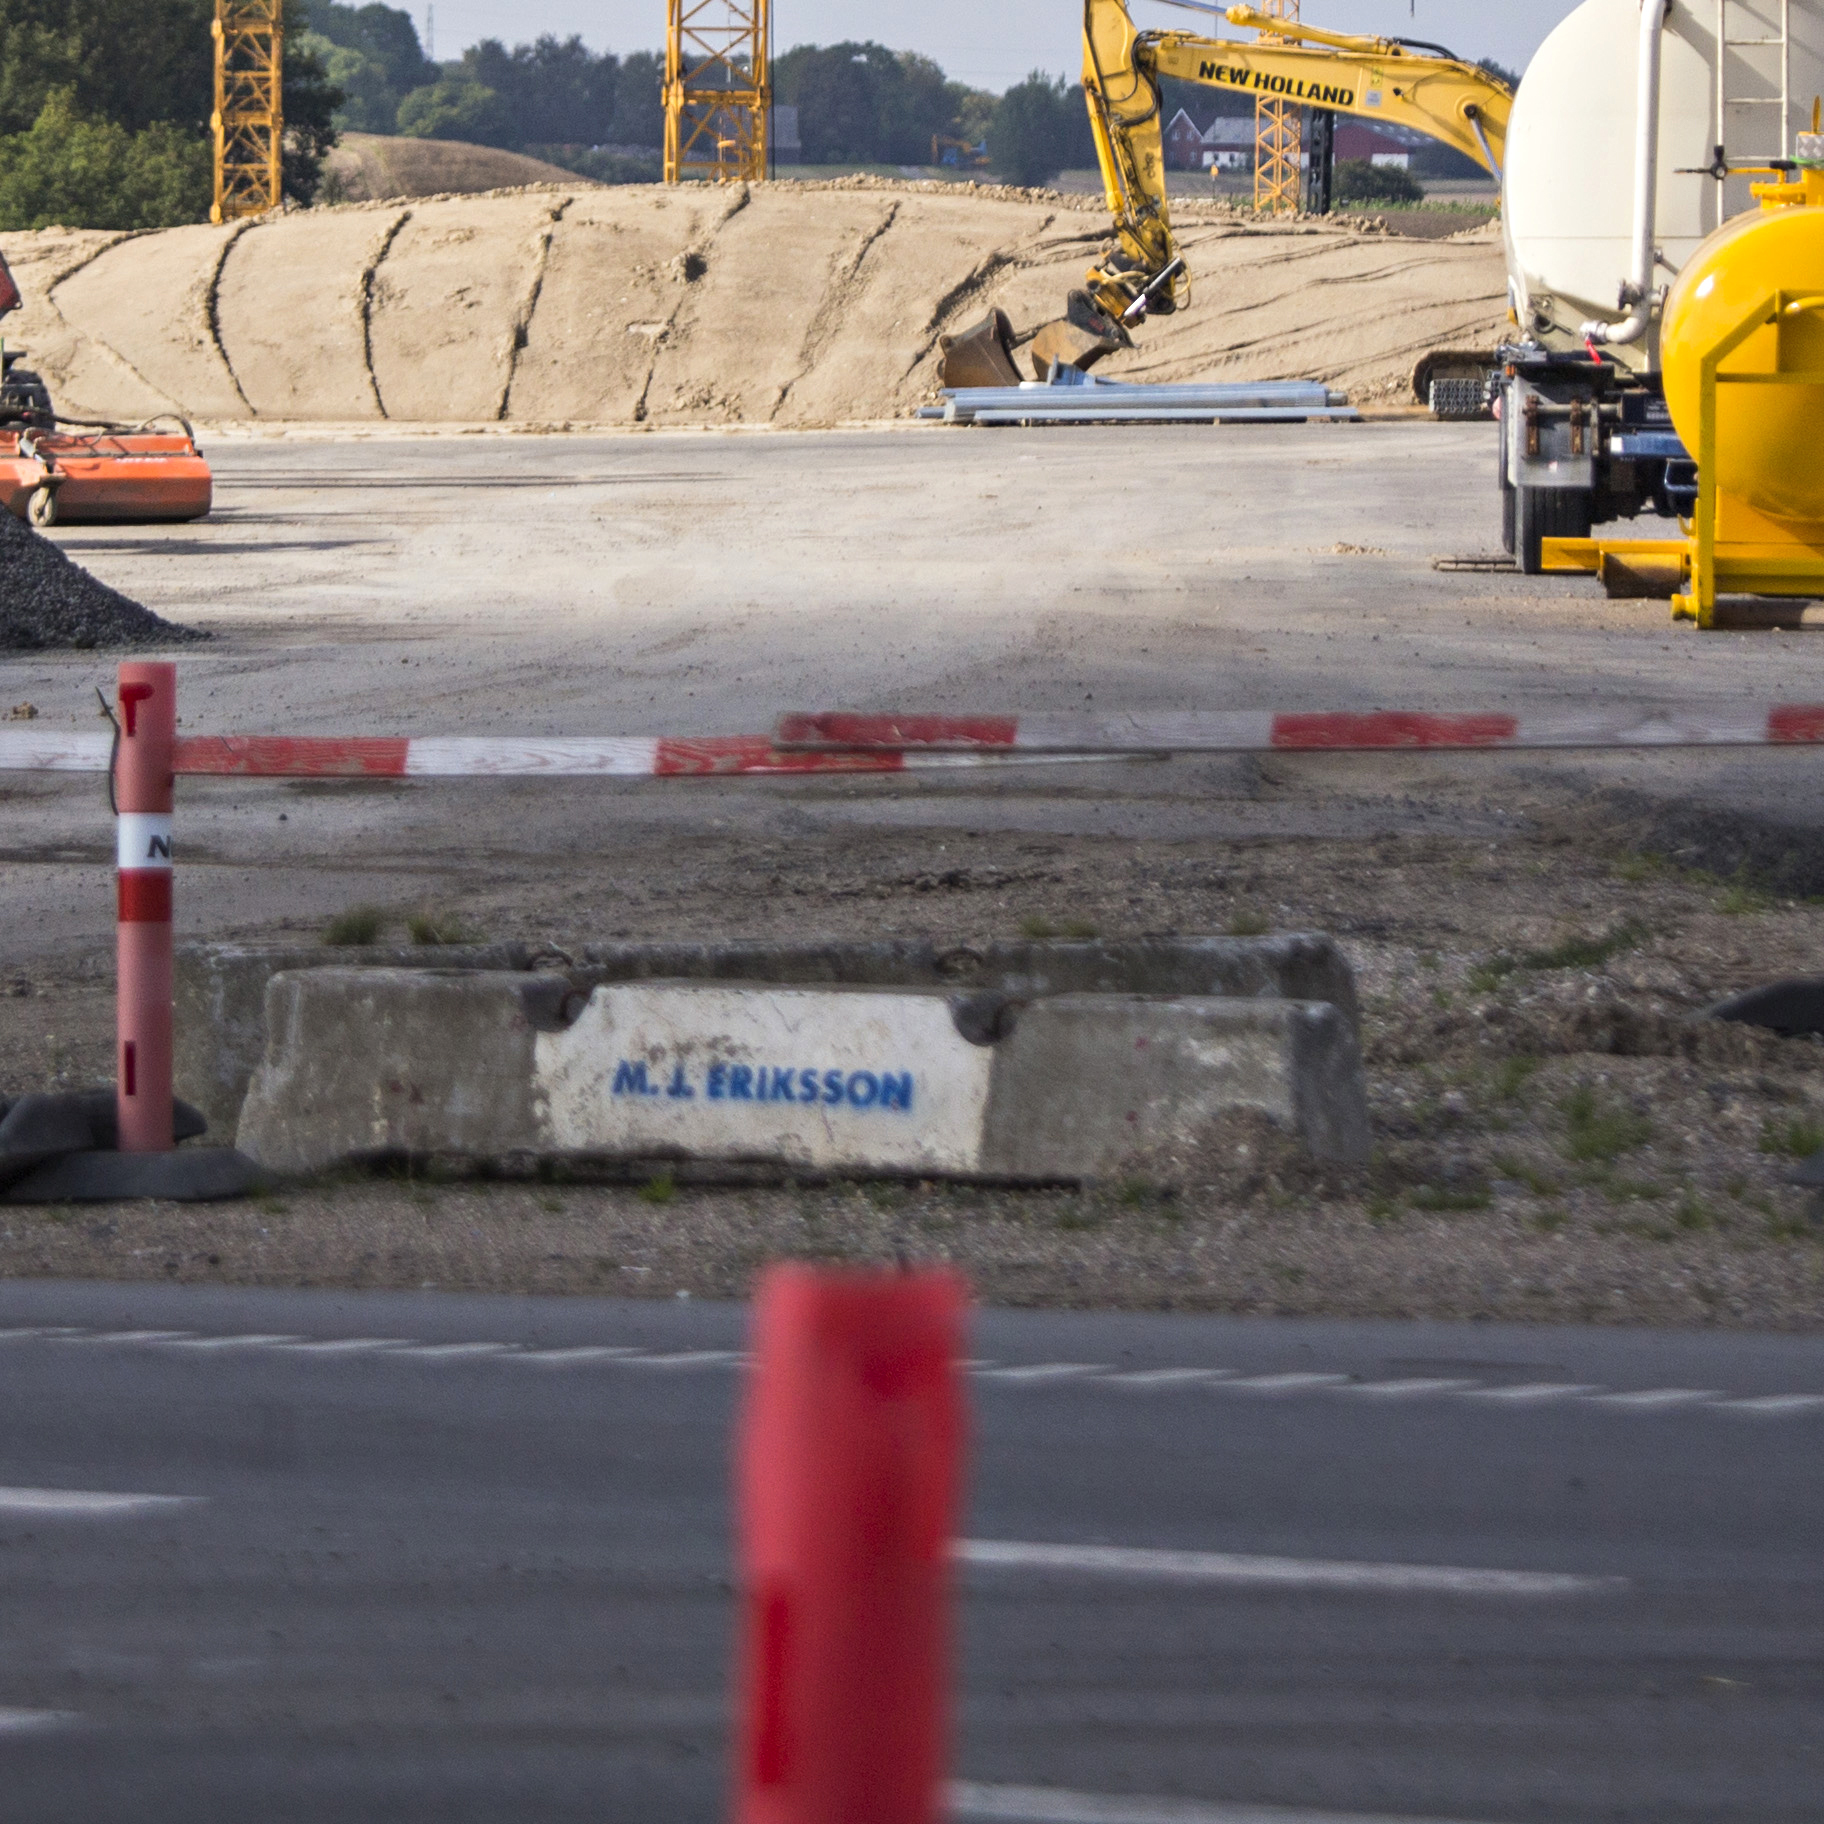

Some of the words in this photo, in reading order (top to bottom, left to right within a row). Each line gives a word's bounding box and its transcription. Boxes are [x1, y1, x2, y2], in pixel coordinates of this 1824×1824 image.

[1199, 60, 1250, 86] NEW
[1253, 72, 1354, 107] HOLLAND
[706, 1062, 914, 1110] ERIKSSON
